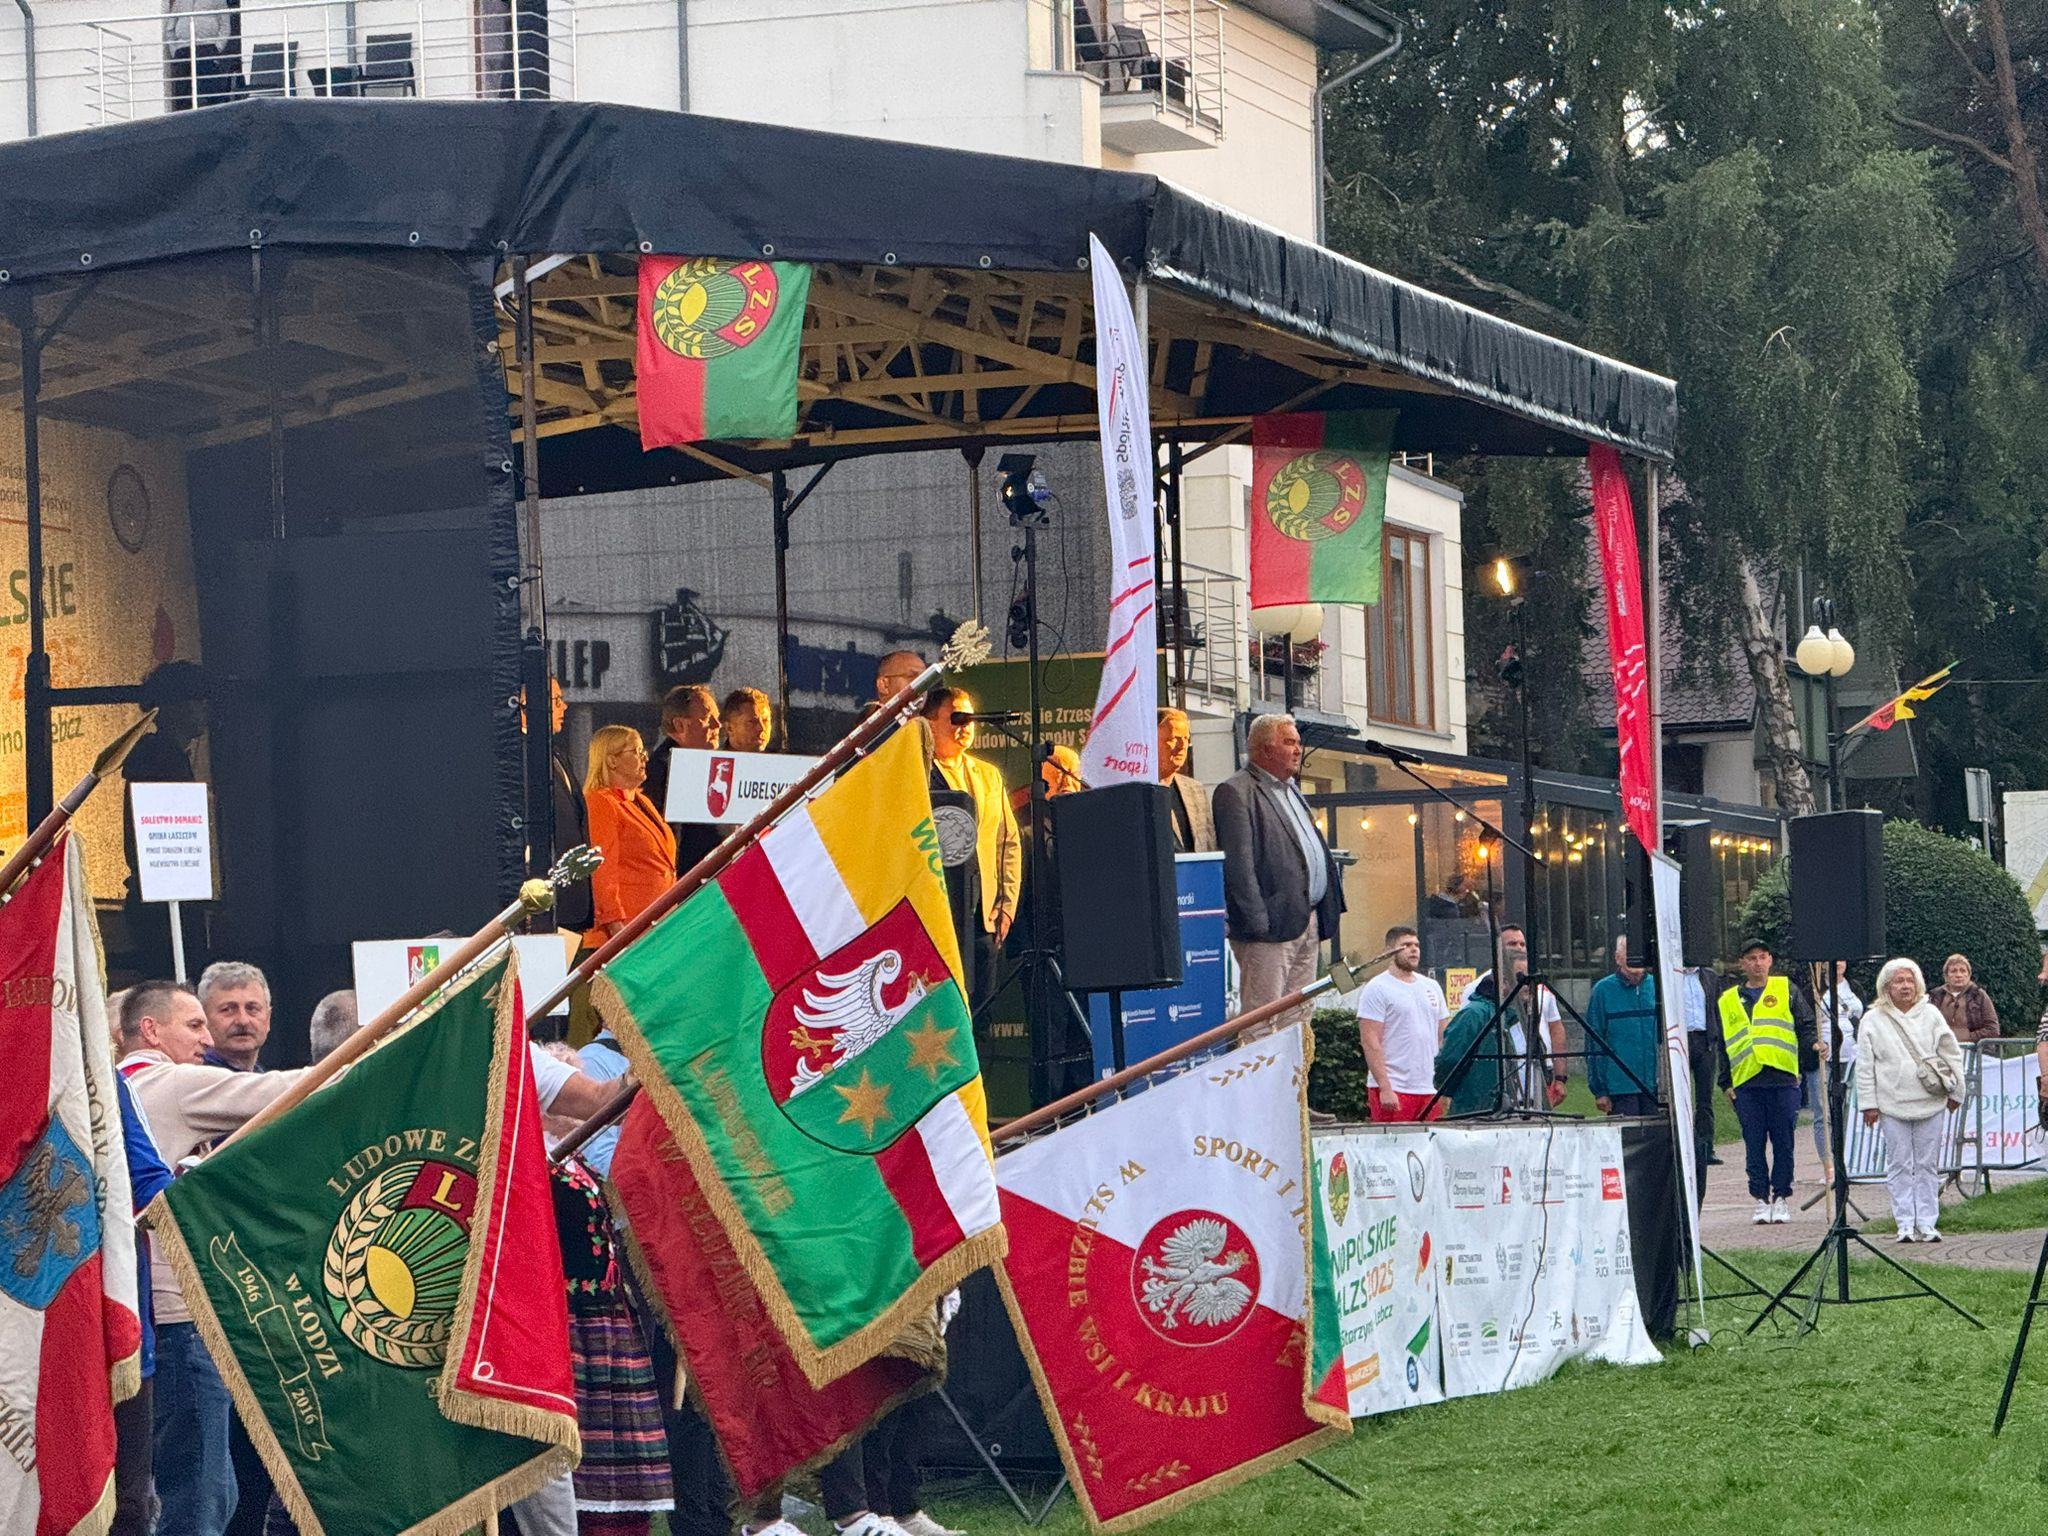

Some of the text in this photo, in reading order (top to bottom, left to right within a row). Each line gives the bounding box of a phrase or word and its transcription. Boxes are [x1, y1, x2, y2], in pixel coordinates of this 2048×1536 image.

[735, 263, 773, 338] LZS
[1333, 462, 1362, 526] LZS
[547, 639, 611, 690] LEP
[1055, 705, 1095, 724] Zrzes
[737, 779, 797, 800] LUBELSK
[326, 1127, 447, 1198] LUDOWE
[1119, 1158, 1147, 1186] W
[1192, 1135, 1297, 1198] SPORT I
[1067, 1182, 1116, 1309] SŁUŻBIE
[236, 1265, 263, 1304] 1946
[292, 1295, 345, 1381] ŁODZI
[1078, 1314, 1116, 1373] WSI
[291, 1386, 319, 1426] 2016
[1133, 1382, 1229, 1418] KRAJU
